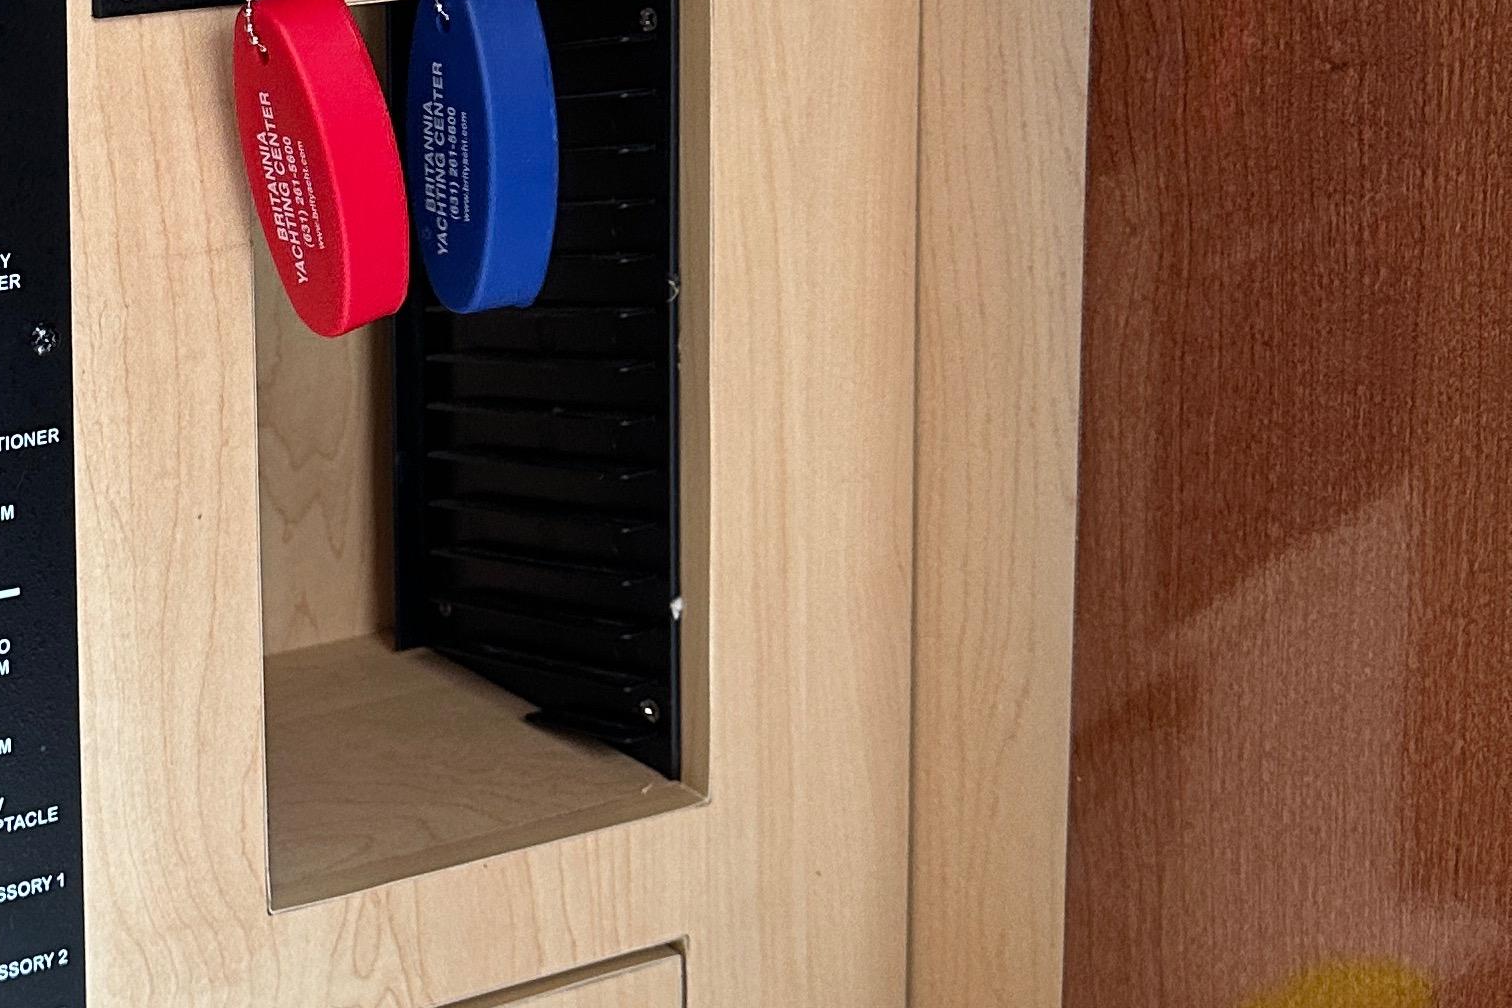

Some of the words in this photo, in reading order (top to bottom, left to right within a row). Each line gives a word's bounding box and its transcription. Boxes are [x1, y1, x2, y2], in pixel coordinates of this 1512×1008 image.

[259, 91, 285, 176] CENTER
[432, 62, 446, 147] CENTER
[257, 131, 289, 242] BRITANNIA
[423, 101, 437, 213] BRITANNIA
[435, 151, 449, 255] YACHTING
[277, 182, 309, 284] YACHTING
[56, 872, 66, 888] 1
[58, 949, 69, 966] 2
